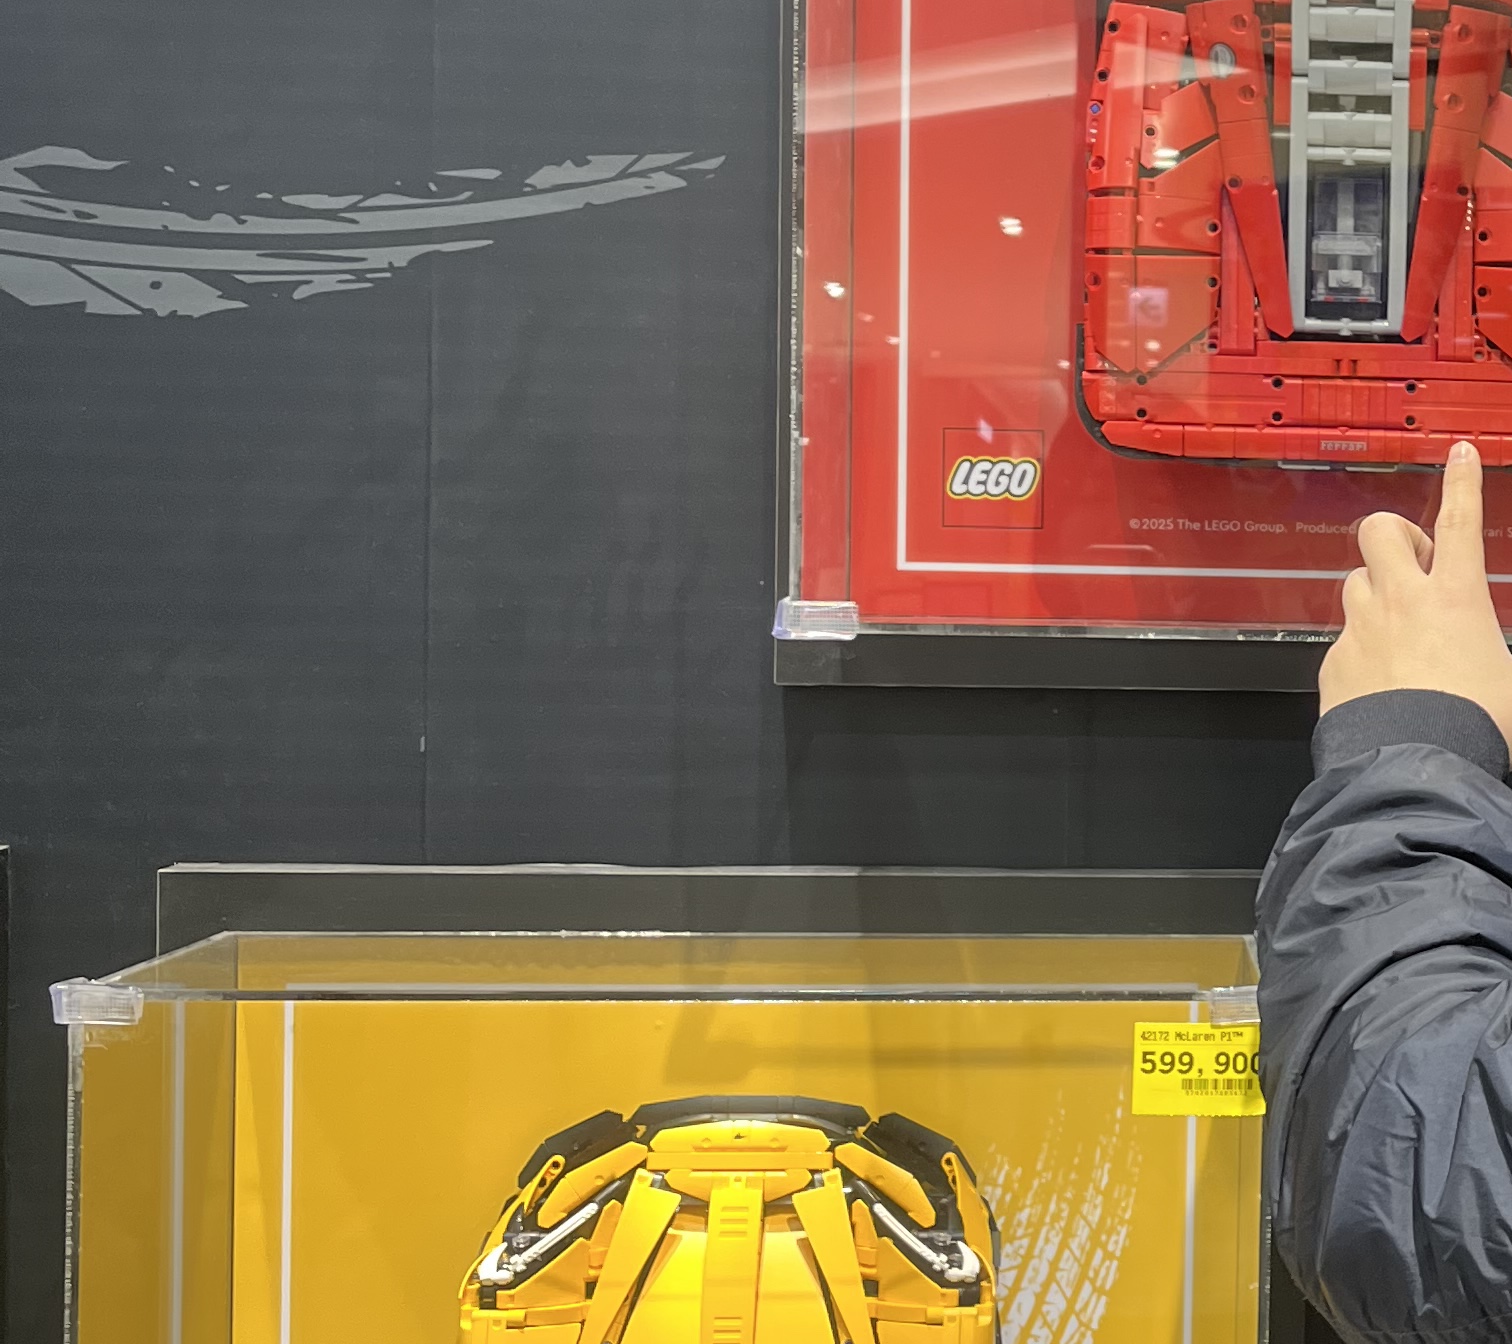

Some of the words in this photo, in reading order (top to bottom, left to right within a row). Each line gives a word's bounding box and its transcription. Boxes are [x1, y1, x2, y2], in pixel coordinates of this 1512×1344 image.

[949, 458, 1038, 498] LEGO
[1177, 519, 1200, 531] The
[1204, 520, 1240, 532] LEGO
[1244, 521, 1287, 533] Group.
[1296, 522, 1358, 534] Produced
[1140, 1031, 1170, 1042] 42172
[1174, 1031, 1215, 1042] McLaren
